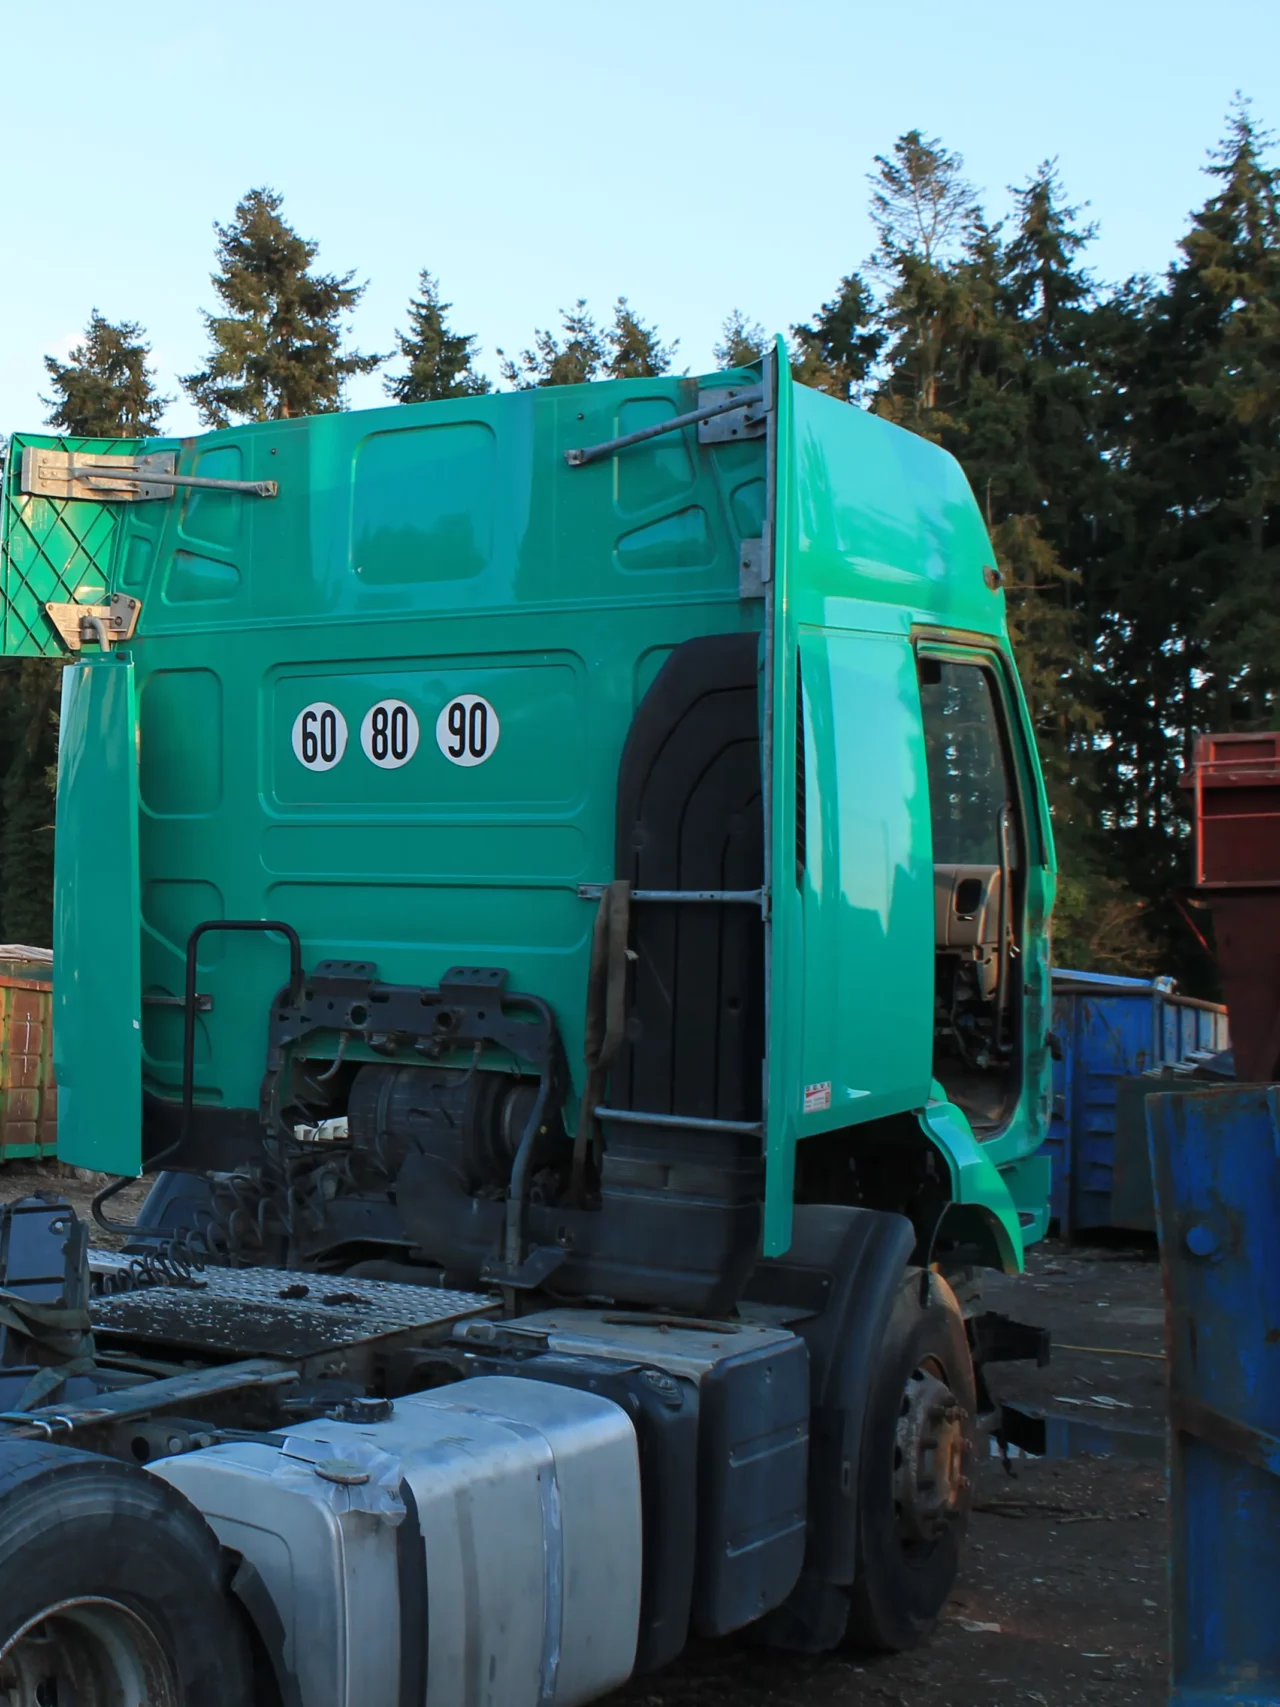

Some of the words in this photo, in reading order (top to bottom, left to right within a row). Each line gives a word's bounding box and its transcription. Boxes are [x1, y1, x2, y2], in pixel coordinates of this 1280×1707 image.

[301, 709, 337, 763] 60
[371, 706, 408, 761] 80
[447, 702, 487, 758] 90
